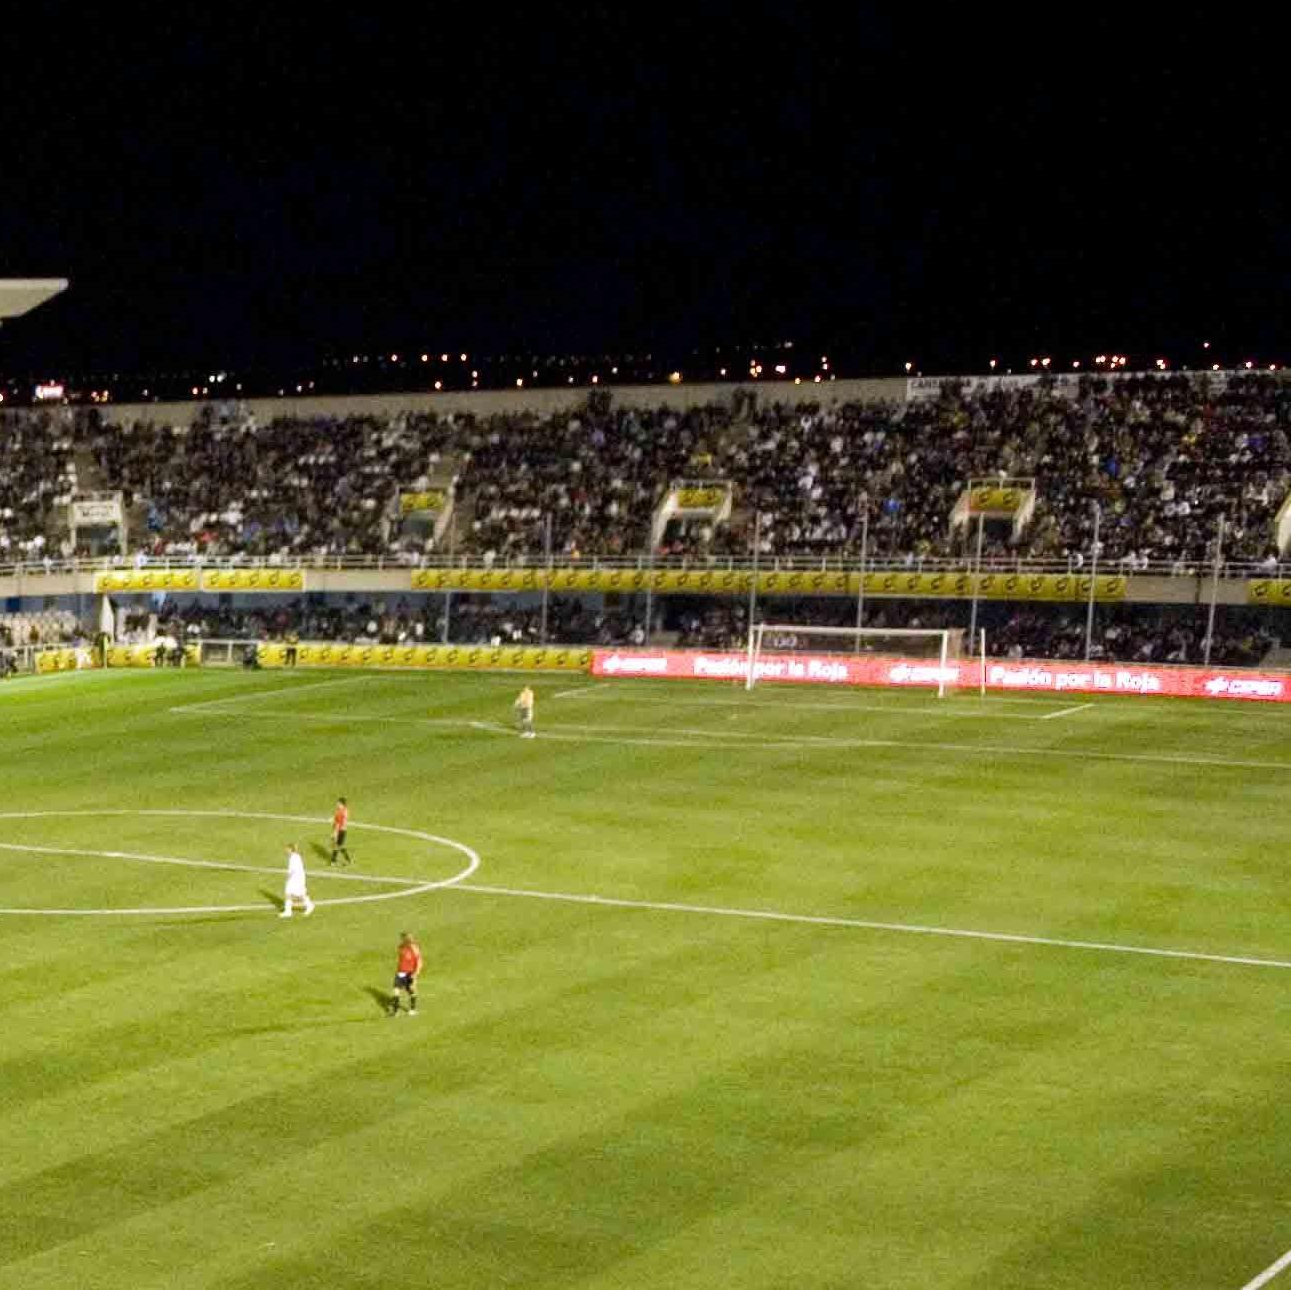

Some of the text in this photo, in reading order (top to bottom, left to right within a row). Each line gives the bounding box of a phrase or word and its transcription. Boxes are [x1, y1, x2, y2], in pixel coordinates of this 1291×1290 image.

[755, 661, 783, 677] por
[809, 660, 848, 681] Roja
[990, 665, 1160, 693] Pasión por la Roja
